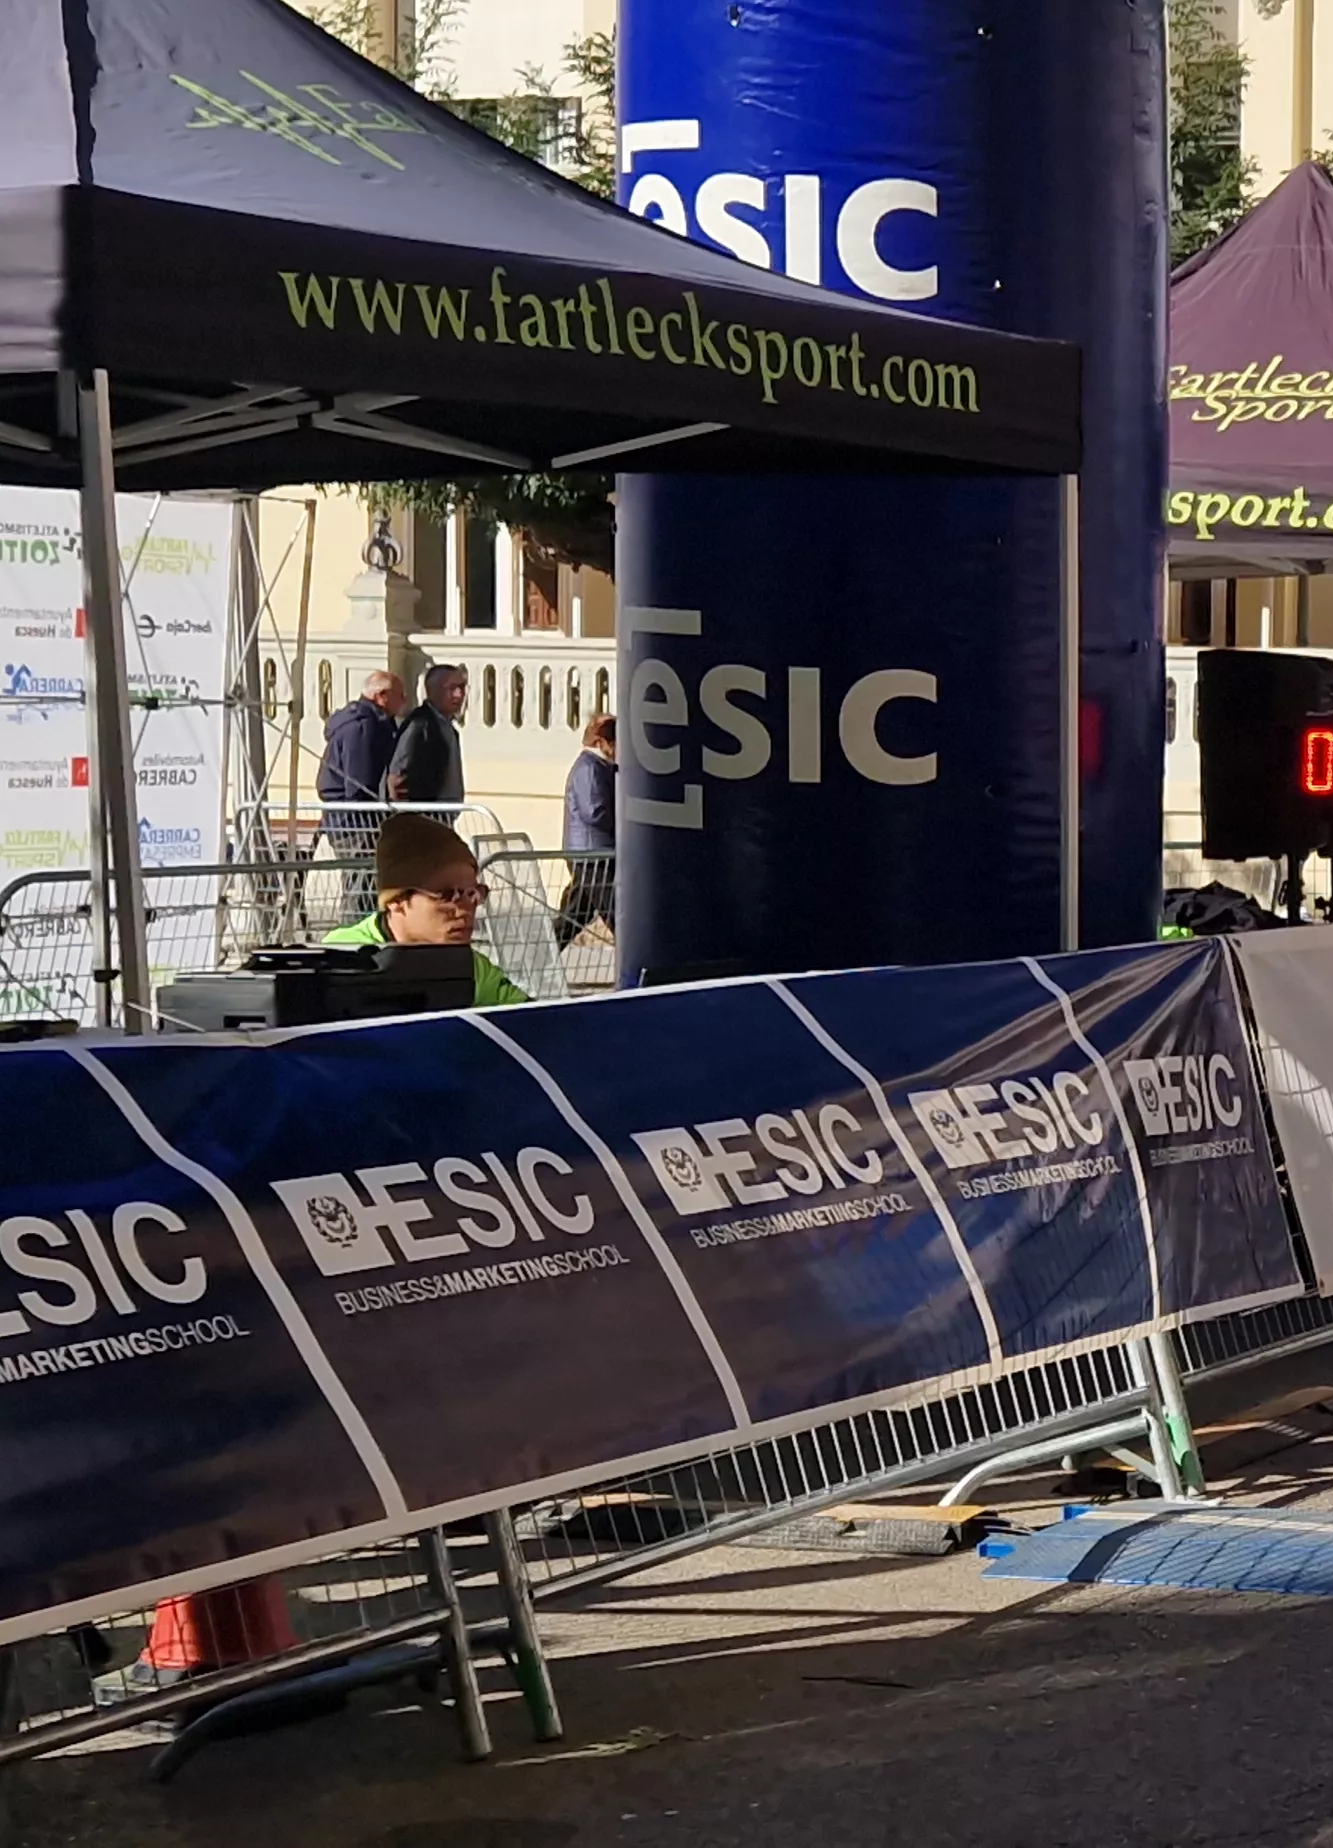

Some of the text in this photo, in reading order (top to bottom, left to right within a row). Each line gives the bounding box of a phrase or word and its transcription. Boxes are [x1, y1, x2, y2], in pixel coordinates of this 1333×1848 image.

[277, 265, 982, 413] www.fartlecksport.com
[963, 1070, 1104, 1161] ESIC
[1156, 1053, 1243, 1134] ESIC
[695, 1104, 885, 1206] ESIC
[354, 1146, 595, 1264] ESIC
[689, 1193, 914, 1249] BUSINESS&MARKETINGSCHOOL
[0, 1200, 208, 1339] SIC
[334, 1244, 631, 1316] BUSINESS&MARKETINGSCHOOL
